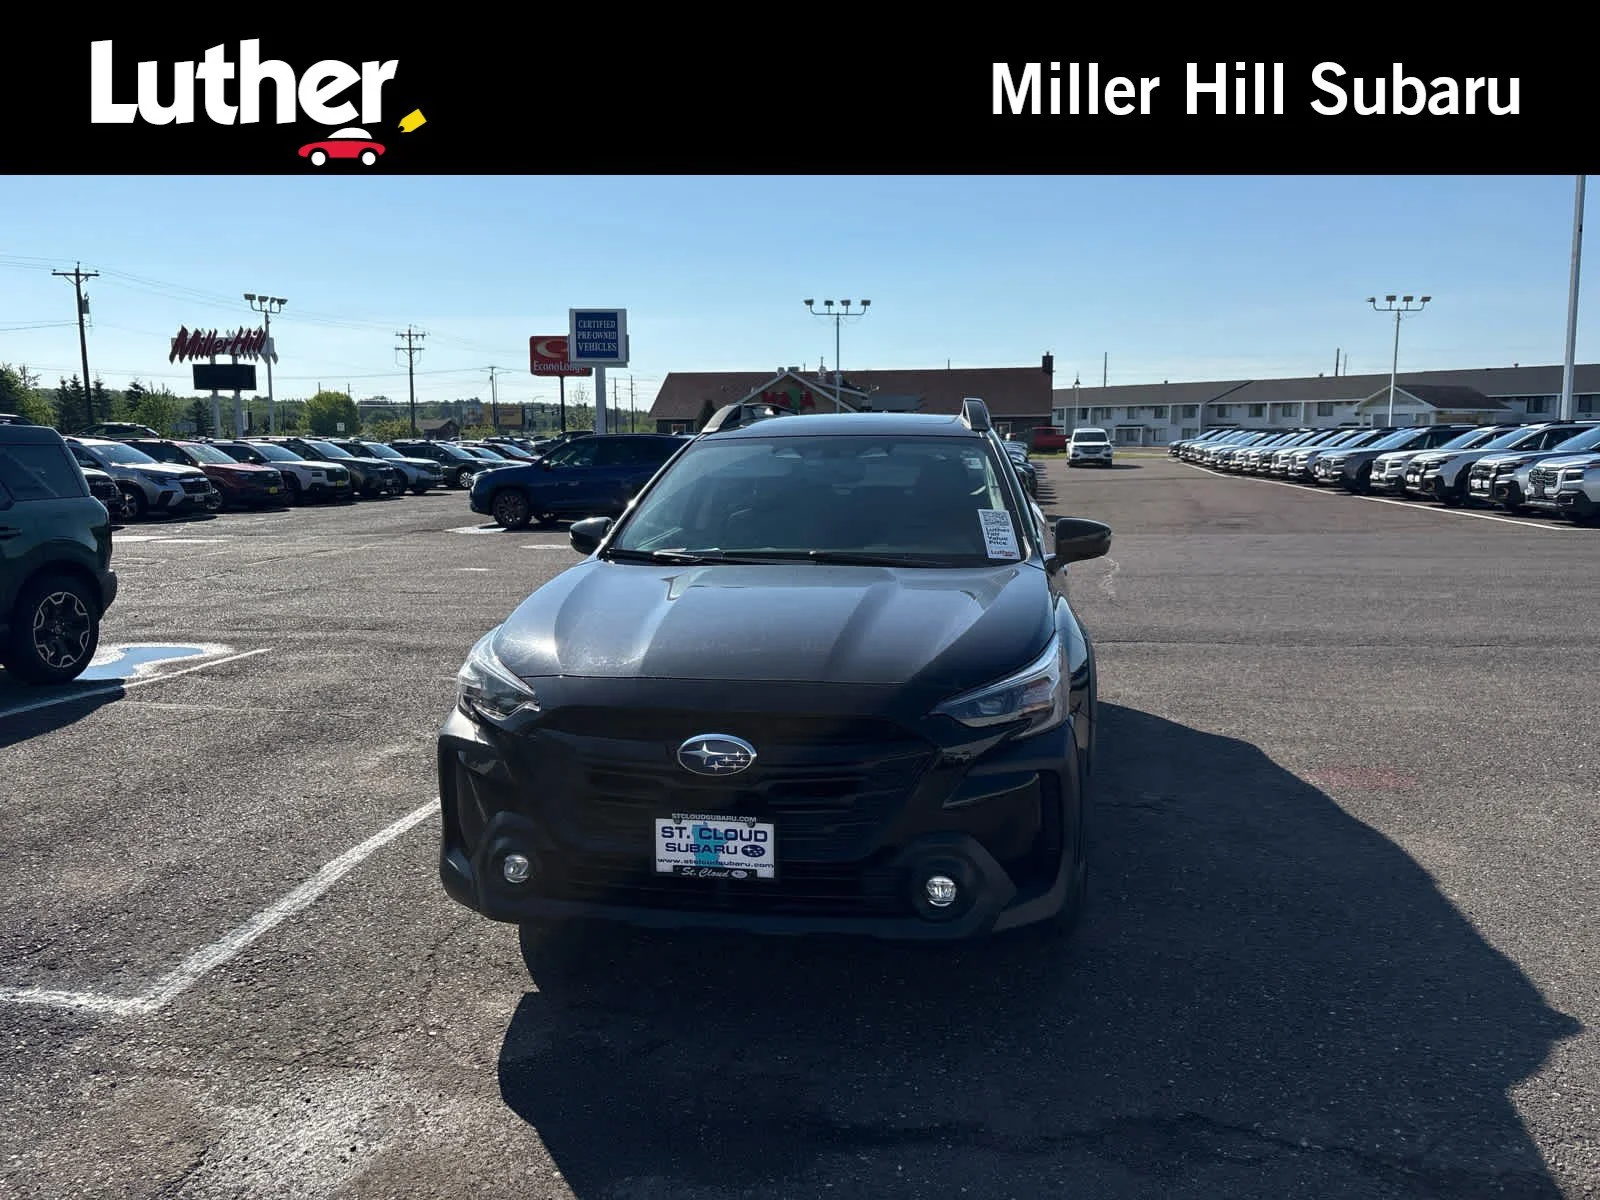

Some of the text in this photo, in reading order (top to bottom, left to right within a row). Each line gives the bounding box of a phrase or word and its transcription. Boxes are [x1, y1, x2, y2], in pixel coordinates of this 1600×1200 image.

[578, 320, 616, 329] CERTIFIED
[578, 342, 617, 352] VEHICLES
[671, 813, 756, 822] STCLOUDSUBARU.COM
[661, 826, 768, 842] ST. CLOUD
[665, 842, 738, 855] SUBARU
[698, 868, 730, 878] Cloud
